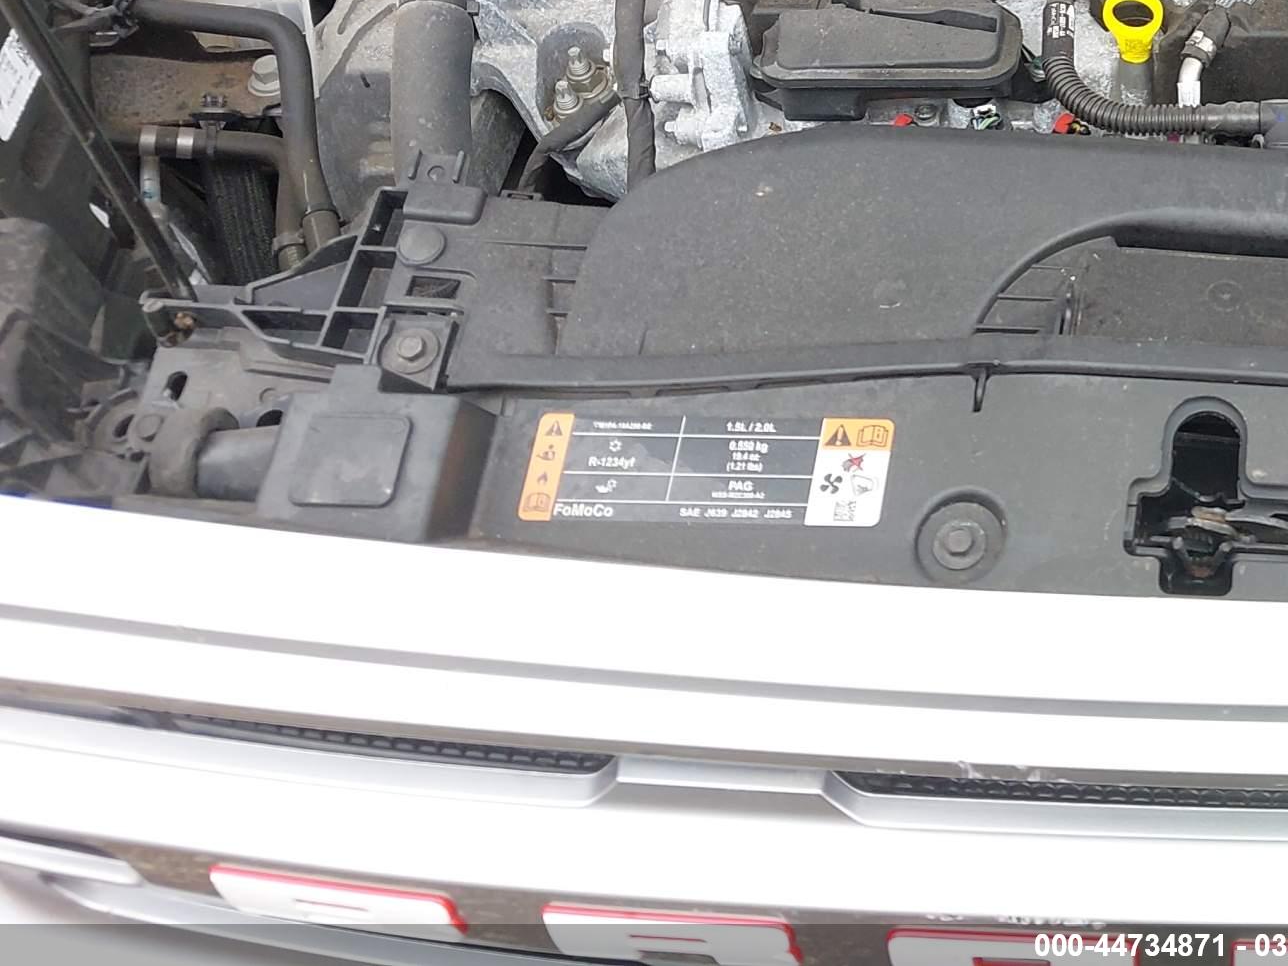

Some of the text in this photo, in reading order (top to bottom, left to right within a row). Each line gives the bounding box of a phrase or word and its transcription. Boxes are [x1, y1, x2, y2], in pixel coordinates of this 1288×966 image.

[588, 456, 636, 470] R-1234yf
[728, 480, 754, 492] PAG
[553, 503, 613, 517] FoMoCo
